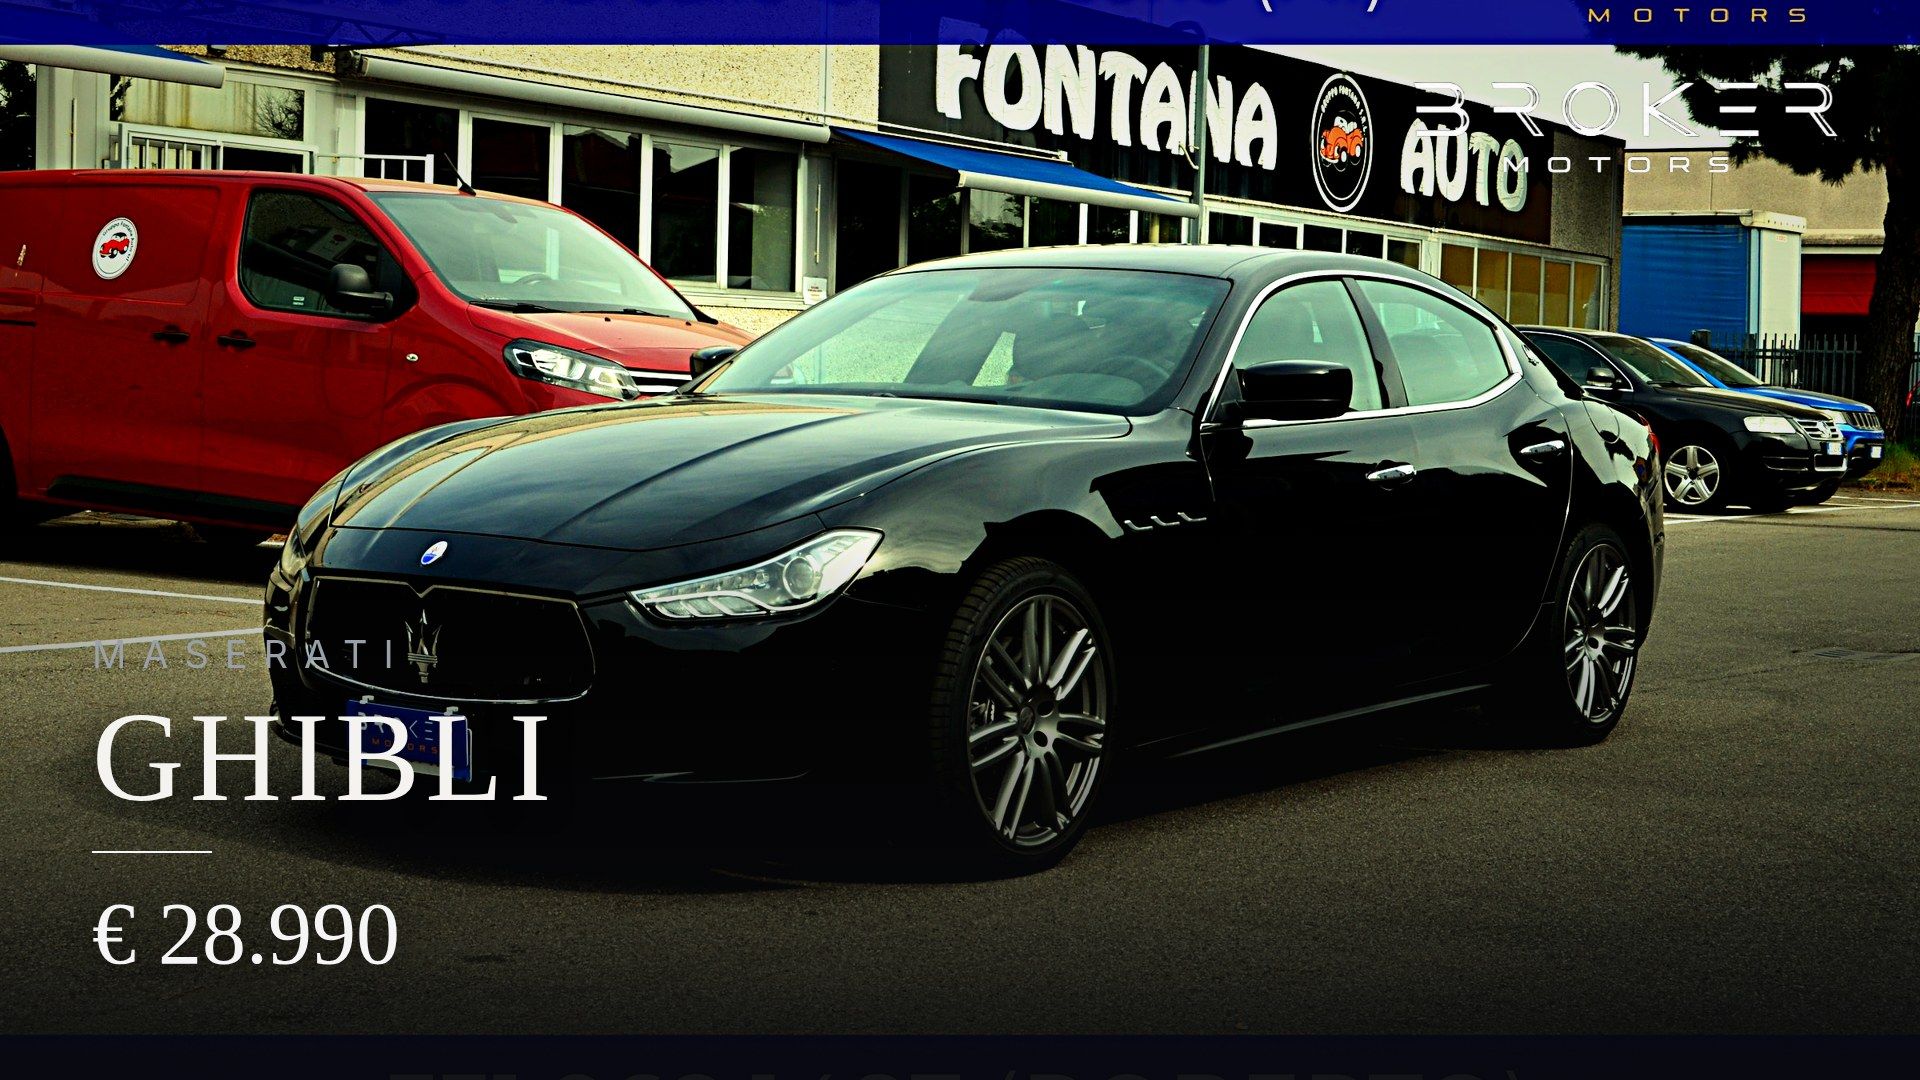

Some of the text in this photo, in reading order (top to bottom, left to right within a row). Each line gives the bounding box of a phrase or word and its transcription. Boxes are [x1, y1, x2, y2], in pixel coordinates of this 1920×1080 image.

[936, 33, 1528, 213] FONTANA AUTO
[370, 736, 440, 755] MOORS
